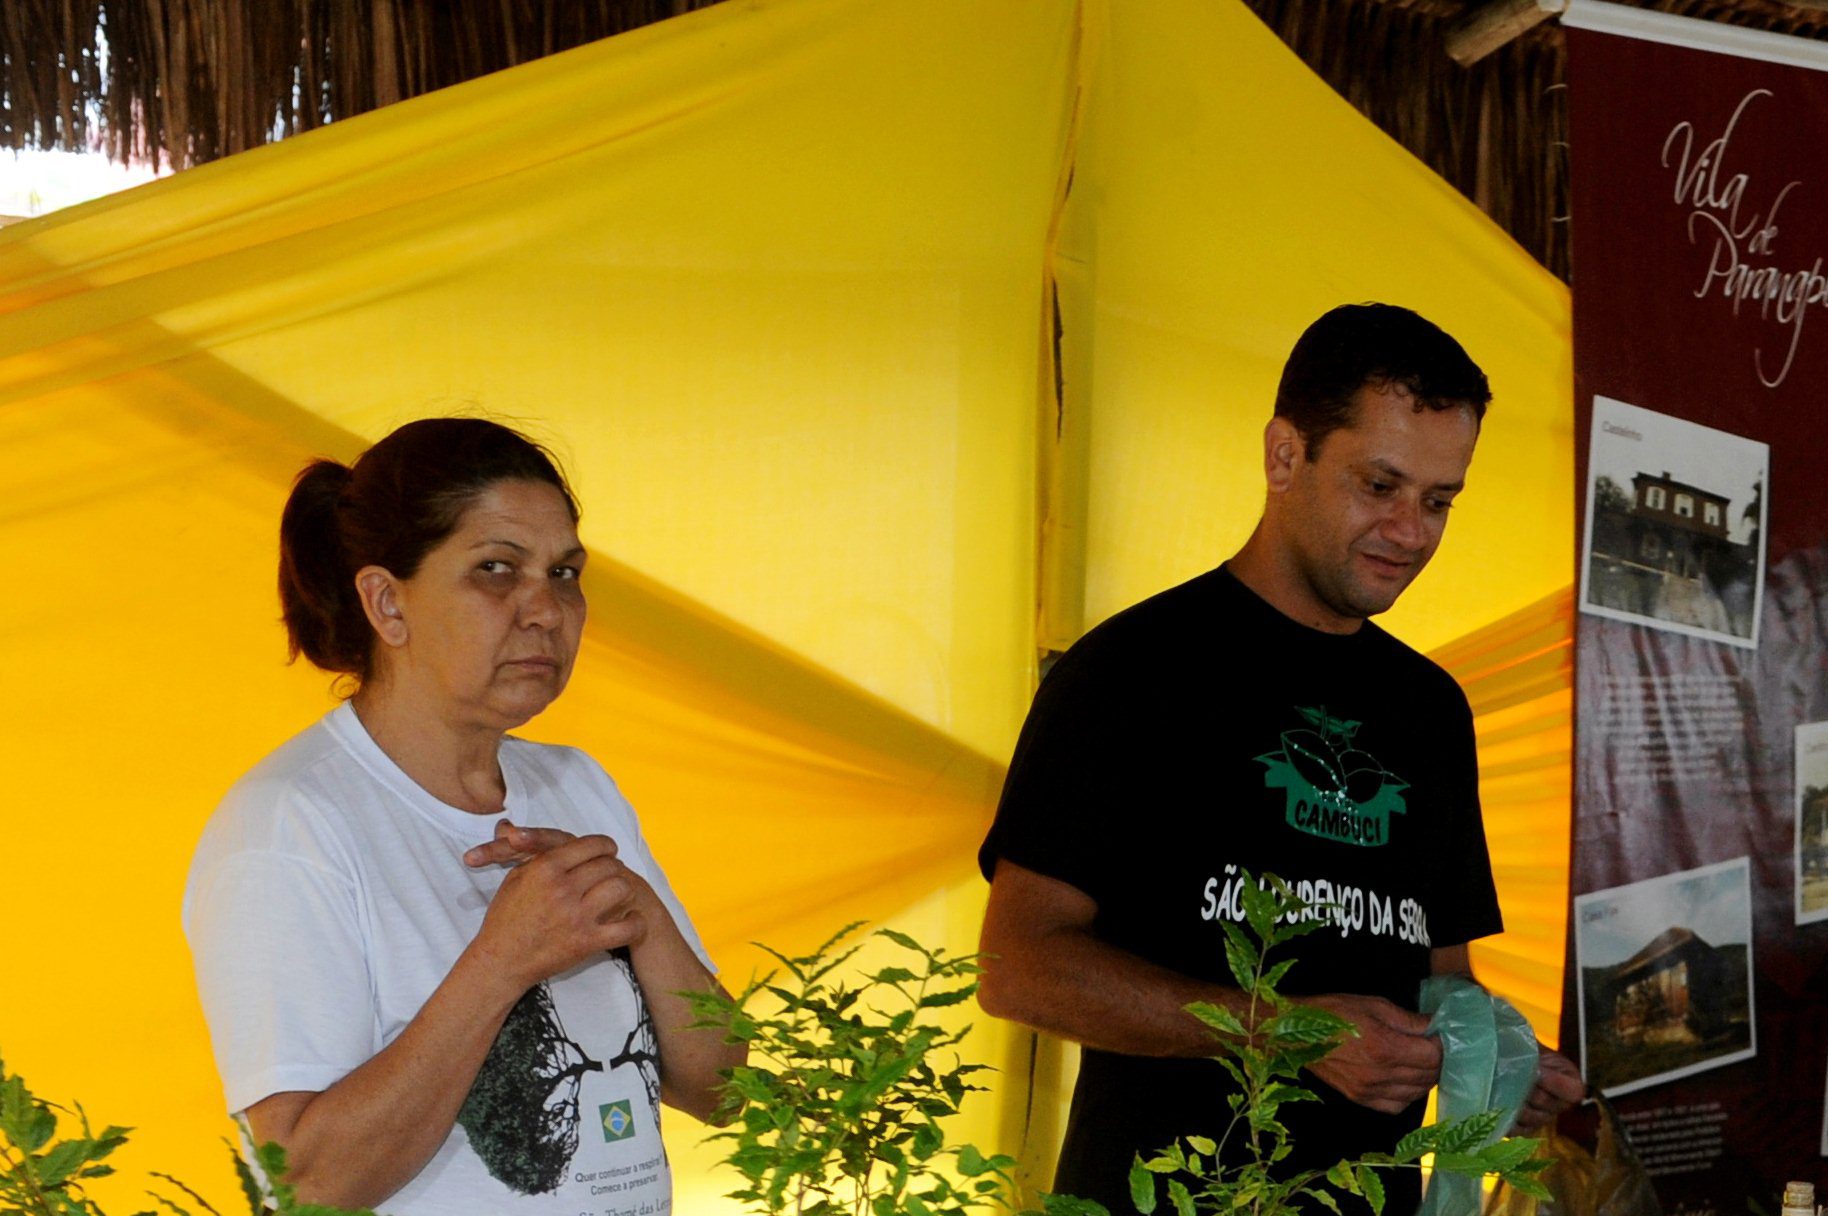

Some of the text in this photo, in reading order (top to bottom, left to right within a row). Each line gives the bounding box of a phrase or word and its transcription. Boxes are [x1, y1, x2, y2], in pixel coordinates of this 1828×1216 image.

[1662, 89, 1772, 238] Vila
[1748, 181, 1801, 255] de
[1295, 799, 1381, 843] CAMBUCI
[1369, 890, 1394, 936] DA
[575, 1172, 597, 1183] Quer
[599, 1166, 632, 1180] continuar
[633, 1164, 638, 1173] a
[591, 1184, 622, 1196] Comece
[623, 1182, 628, 1191] a
[640, 1201, 654, 1216] das
